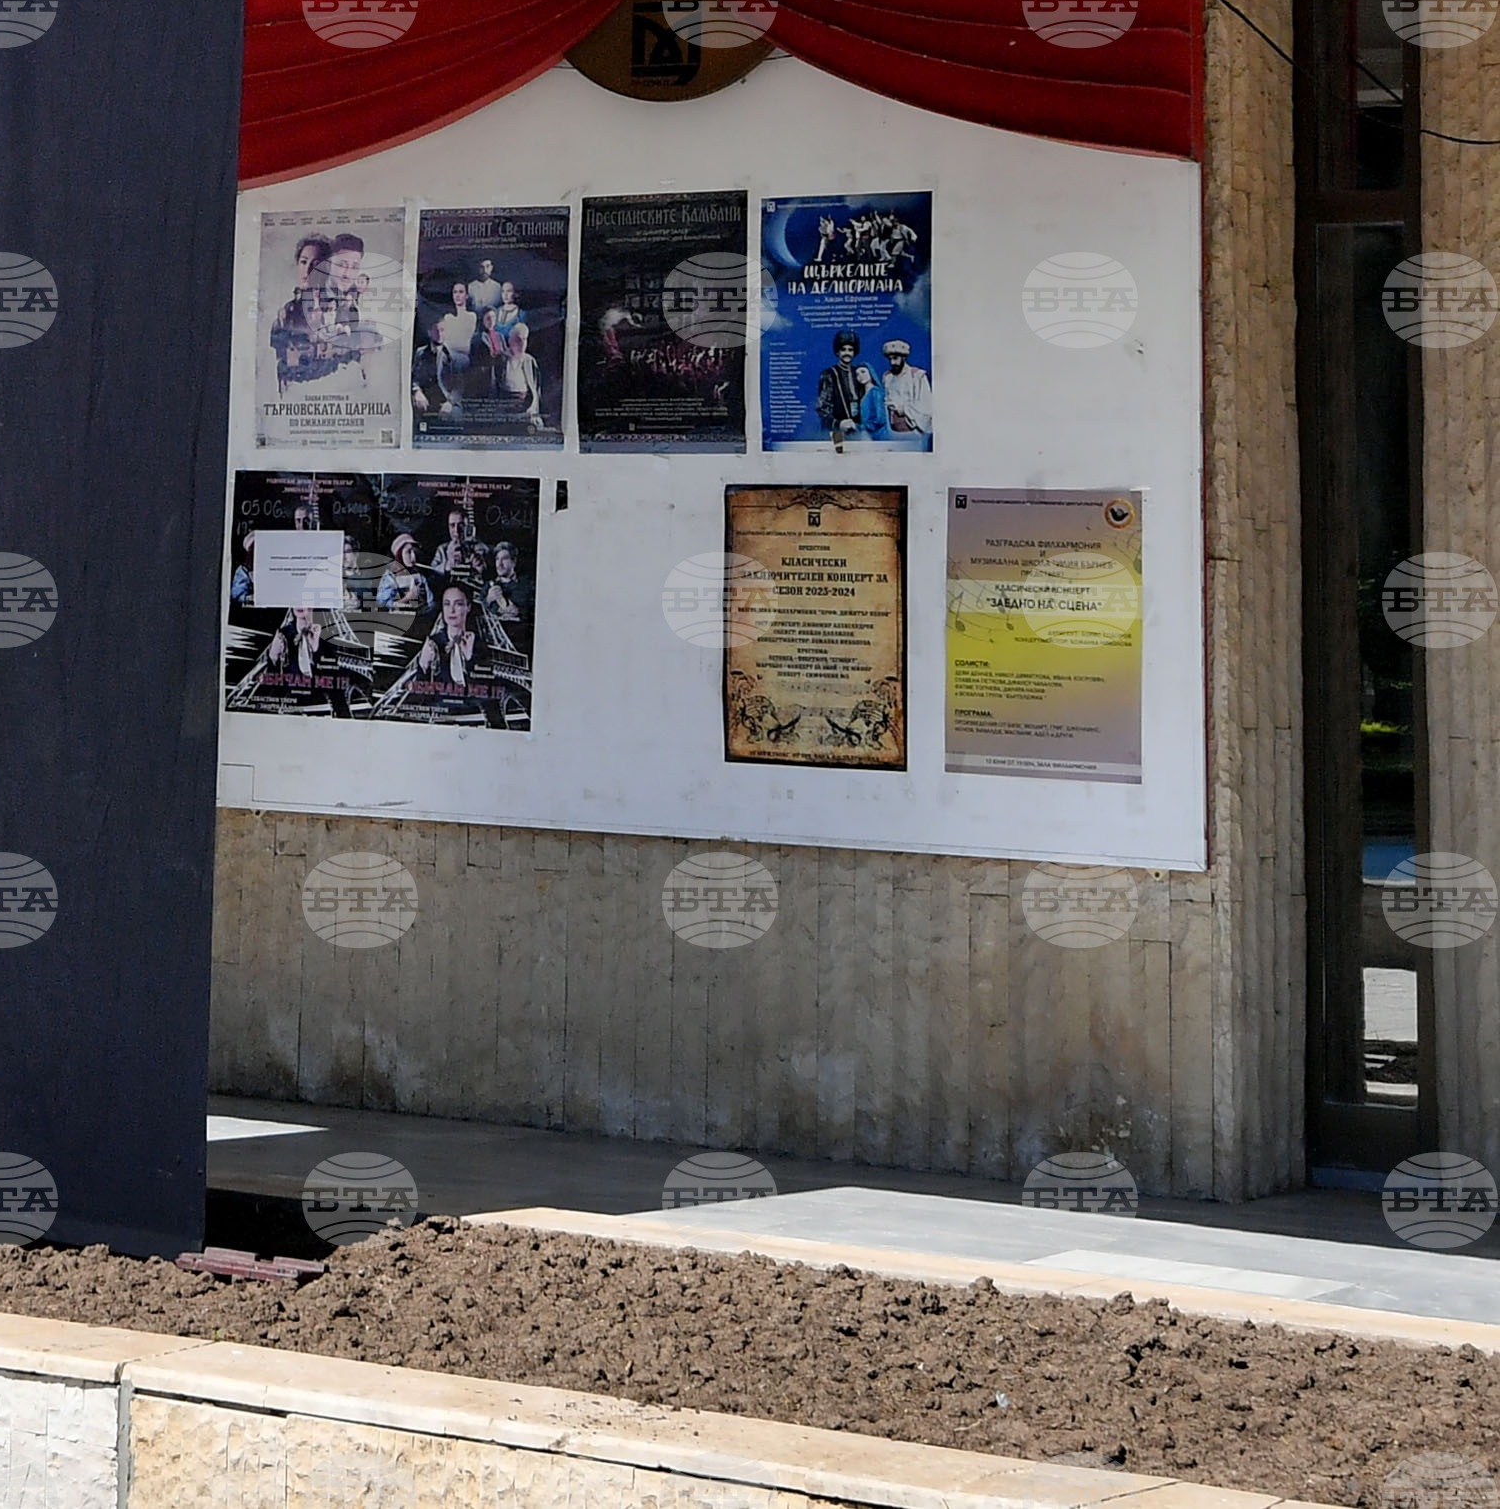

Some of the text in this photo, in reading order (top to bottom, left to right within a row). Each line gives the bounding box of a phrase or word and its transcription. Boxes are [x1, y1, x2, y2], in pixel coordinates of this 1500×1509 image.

[804, 263, 889, 280] ЩЪРКЕЛИТЕ
[788, 279, 903, 295] НА ДЕЛИОРМАНА
[263, 403, 391, 417] ТЪРНОВСКАТА ЦАРИЦА
[337, 418, 364, 426] СТАНЕВ
[986, 538, 1101, 550] РАЗГРАДСКА ФИЛХАРМОНИЯ
[781, 557, 847, 568] КЛАСИЧЕСКИ
[970, 557, 1019, 566] МУЗИКАЛНА
[742, 570, 889, 584] ЗАКЛЮЧИТЕЛЕН КОНЦЕРТ ЗА
[772, 586, 856, 597] СЕЗОН 2023-2024
[995, 584, 1091, 595] КЛАСИЧЕСКИ КОНЦЕРТ
[986, 597, 1102, 612] "ЗАЕДНО НА СЦЕНА"
[955, 659, 990, 668] СОЛИСТИ:
